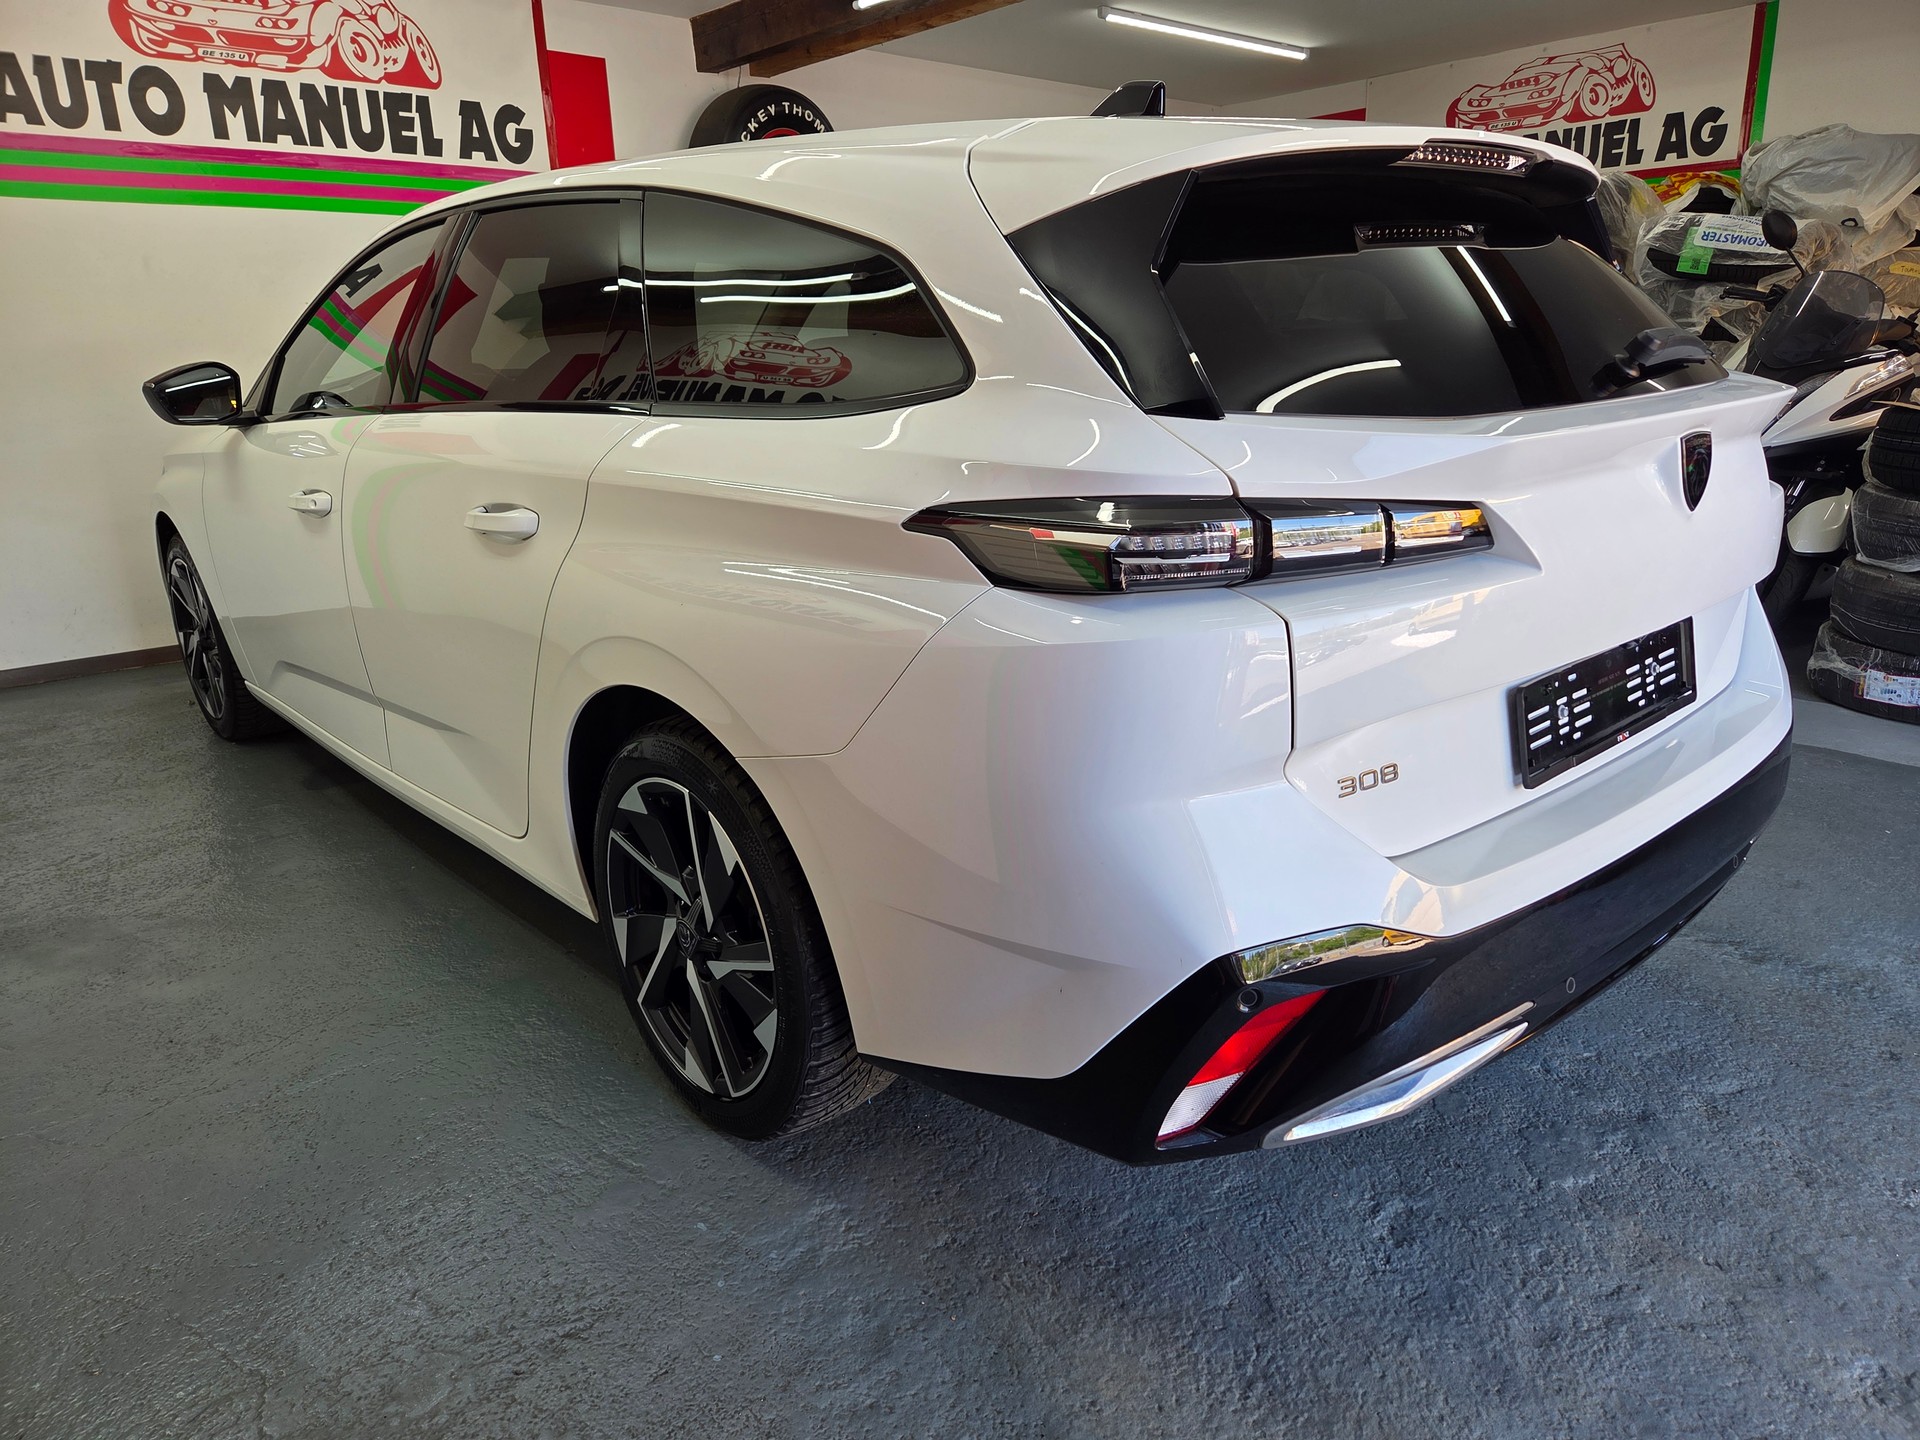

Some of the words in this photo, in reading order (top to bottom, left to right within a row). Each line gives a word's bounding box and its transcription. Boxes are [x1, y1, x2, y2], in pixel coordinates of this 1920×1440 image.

[219, 51, 236, 59] 135
[0, 51, 186, 137] AUTO
[203, 72, 443, 157] MANUEL
[458, 99, 534, 165] AG
[740, 103, 776, 142] CKEY
[782, 101, 826, 134] THOM
[1523, 117, 1644, 169] UEL
[1654, 106, 1728, 162] AG
[1701, 230, 1769, 248] ROMASTER
[1337, 762, 1399, 799] 308
